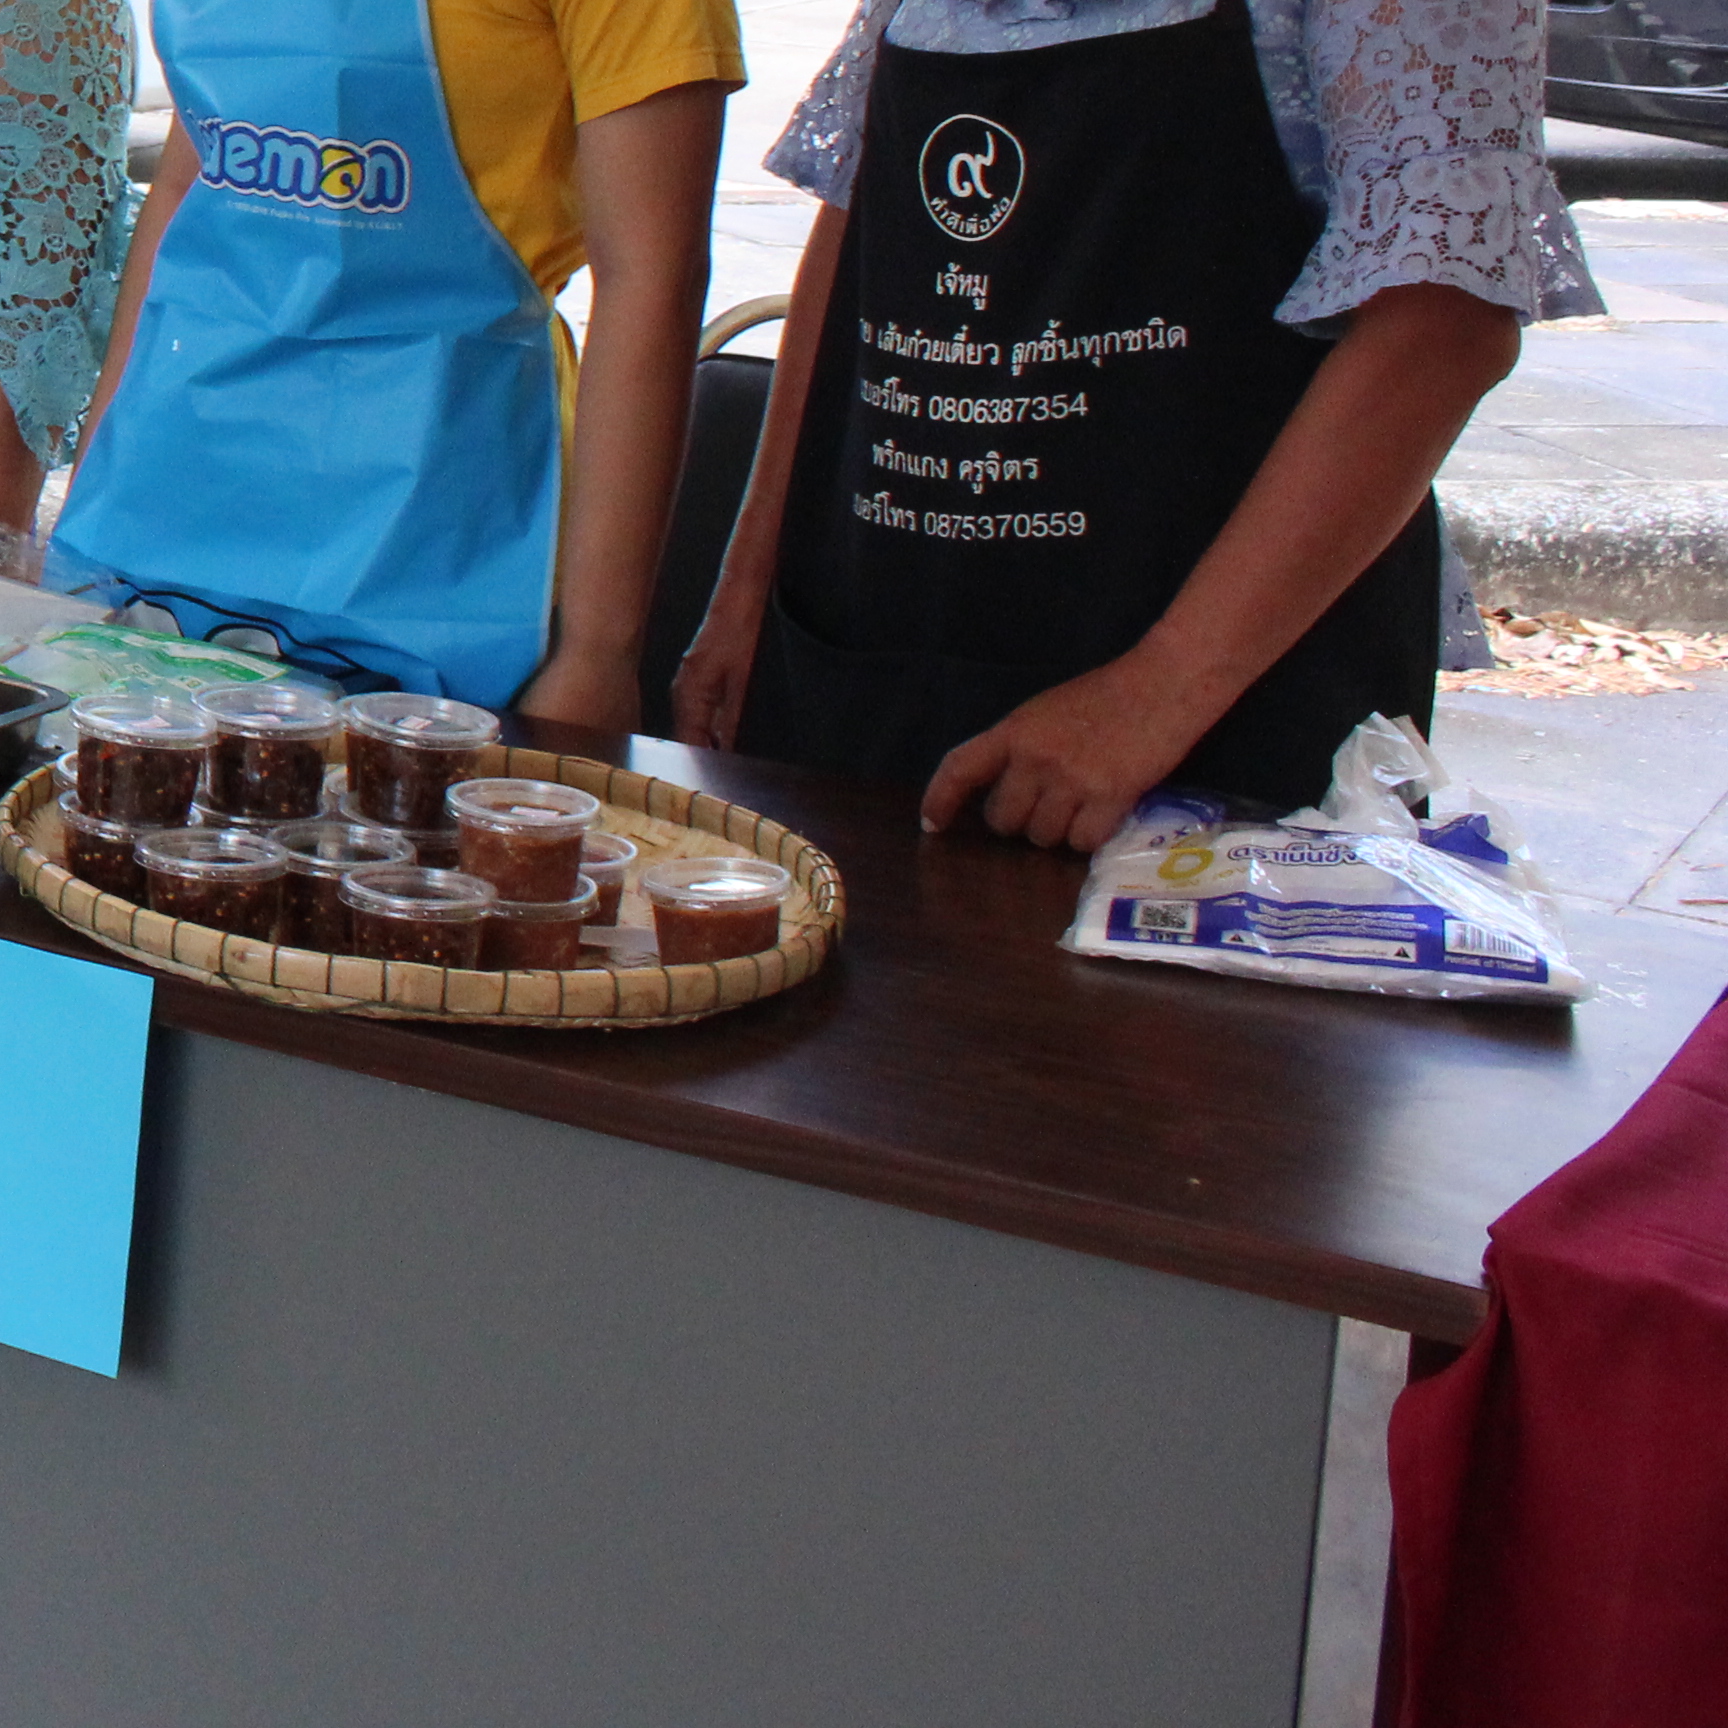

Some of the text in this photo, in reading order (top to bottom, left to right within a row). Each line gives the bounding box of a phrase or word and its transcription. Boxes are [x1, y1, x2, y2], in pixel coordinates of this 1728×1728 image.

[935, 262, 989, 311] เจ้หมู
[1010, 316, 1188, 377] ลูกชิ้นทุกชนิด
[928, 392, 1090, 424] 0806387354
[872, 438, 1040, 495] พริกแกง ครูจิตร
[924, 511, 1087, 541] 0875370559
